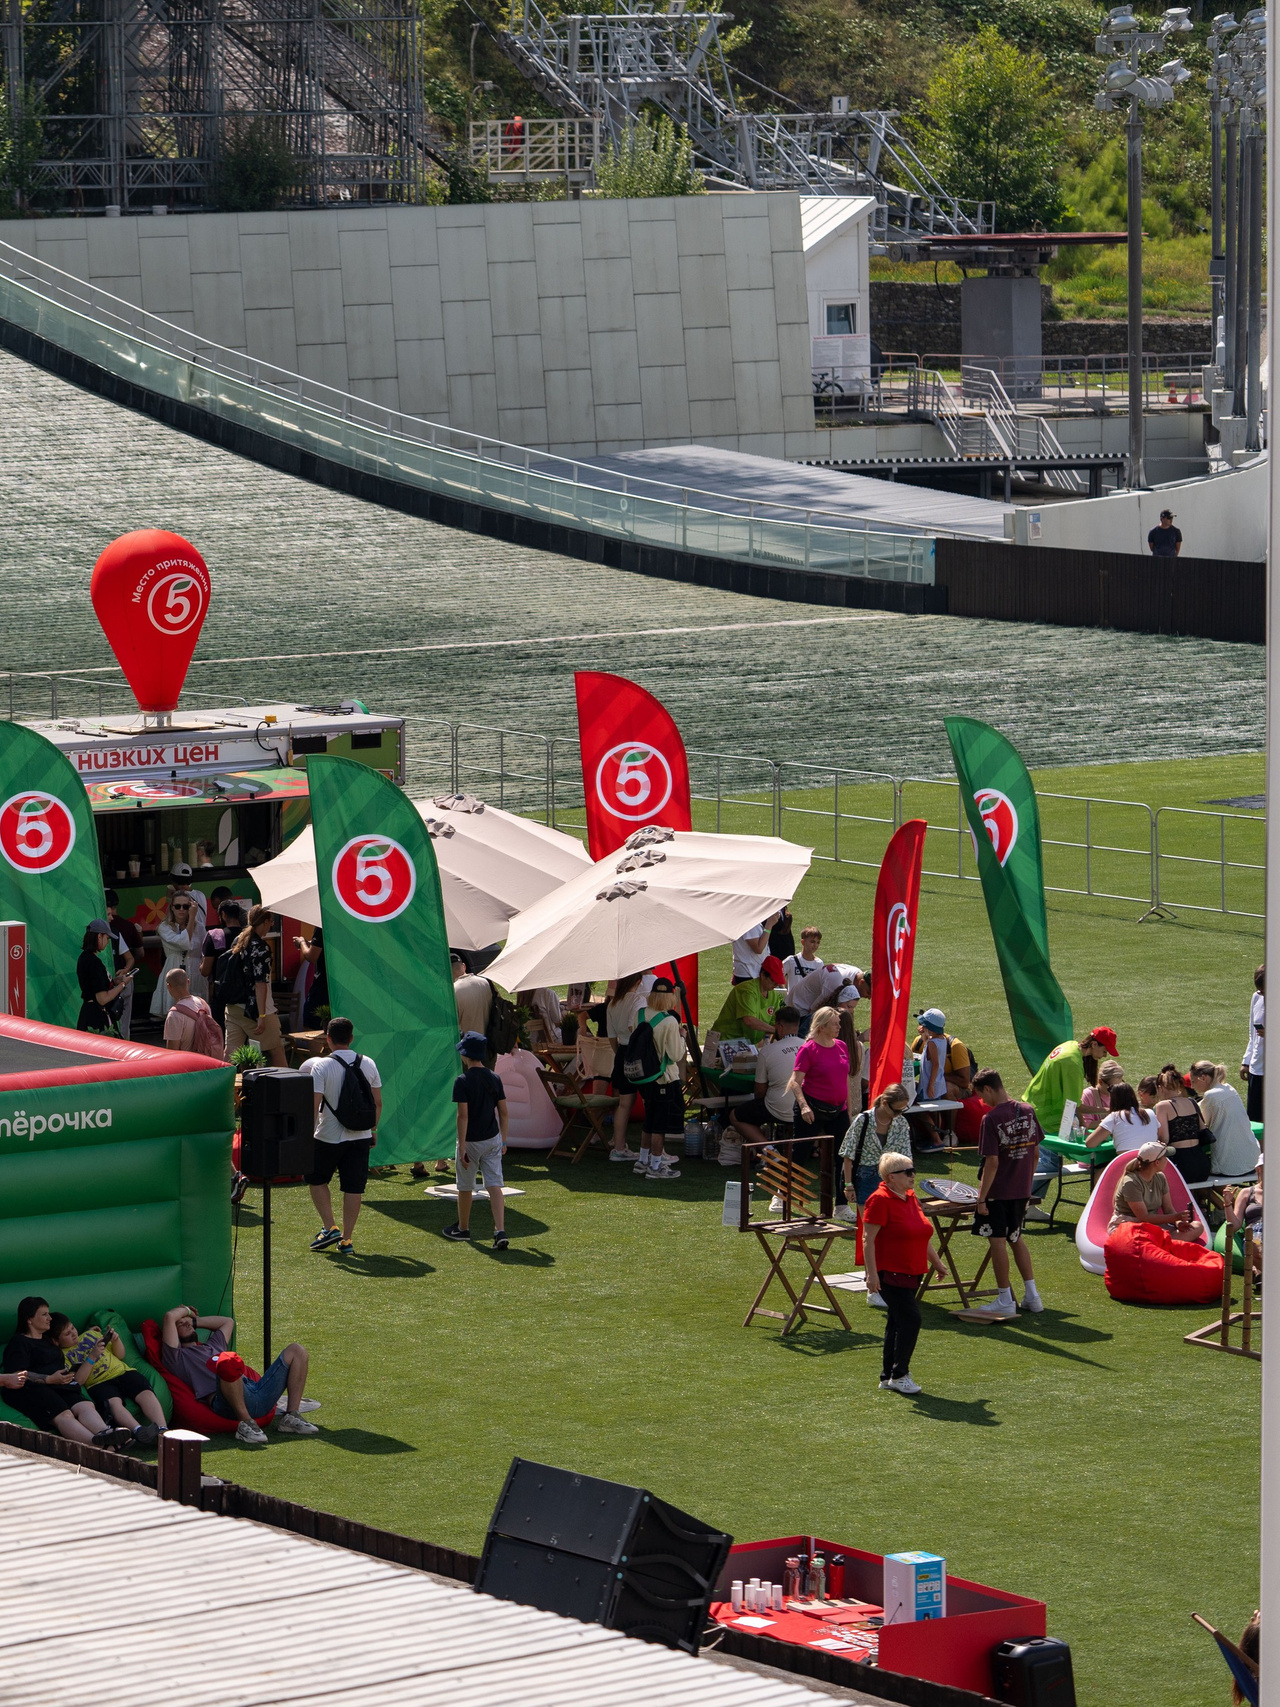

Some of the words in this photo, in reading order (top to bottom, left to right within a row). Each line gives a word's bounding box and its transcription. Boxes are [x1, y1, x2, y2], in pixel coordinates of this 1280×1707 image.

[837, 98, 842, 110] 1
[131, 568, 156, 604] Место
[155, 558, 209, 593] притяжения
[163, 578, 194, 624] 5
[77, 747, 167, 771] низких
[173, 744, 219, 766] цен
[615, 747, 655, 807] 5
[15, 797, 55, 858] 5
[355, 840, 395, 906] 5
